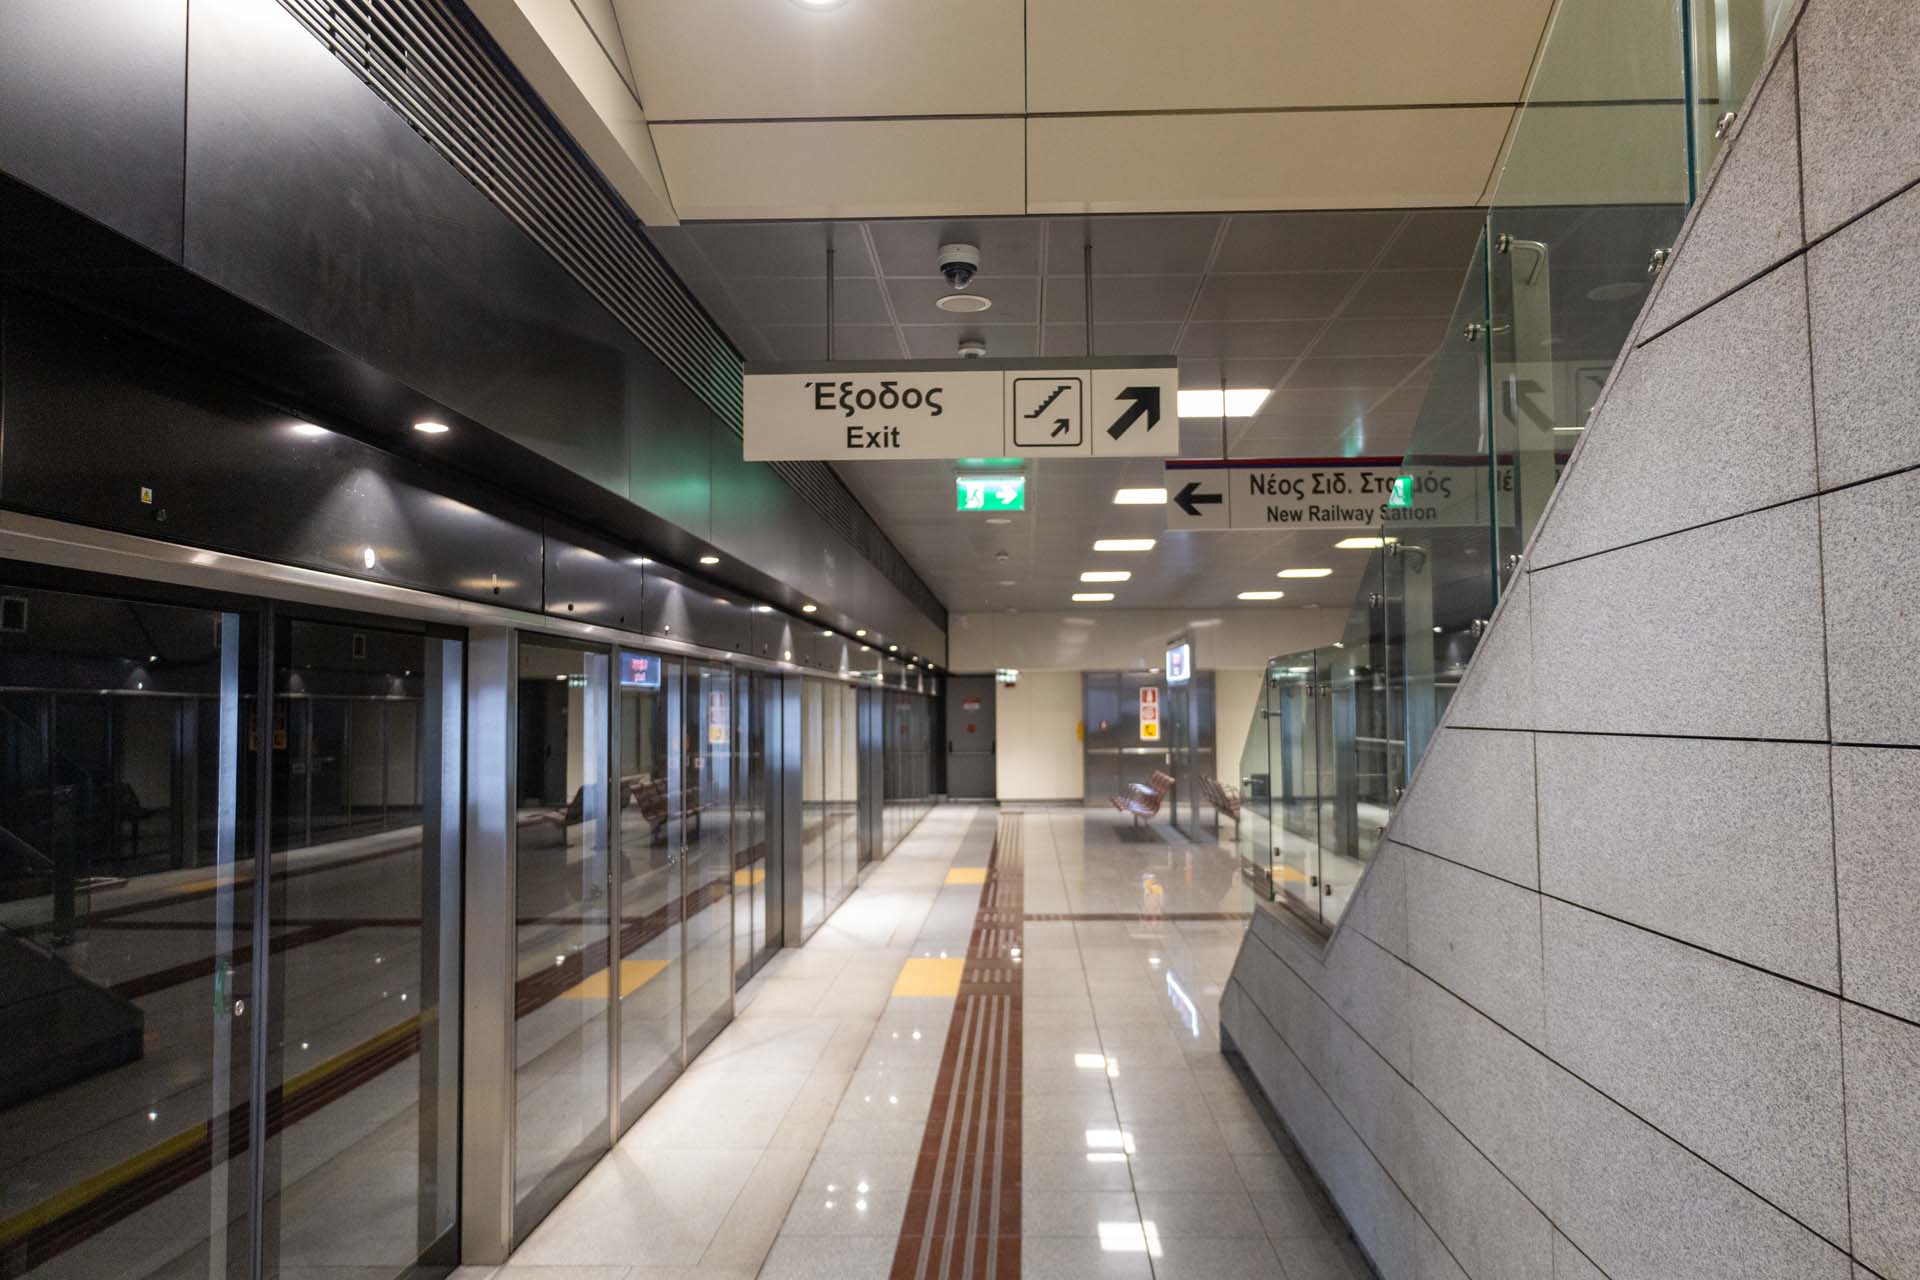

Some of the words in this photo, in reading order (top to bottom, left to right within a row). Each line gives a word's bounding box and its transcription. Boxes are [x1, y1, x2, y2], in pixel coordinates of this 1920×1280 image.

[804, 381, 944, 418] Έξοδος
[846, 425, 901, 449] Exit
[1250, 472, 1305, 501] Νέος
[1311, 472, 1353, 495] Σιδ.
[1266, 505, 1304, 523] New
[1308, 504, 1375, 526] Railway
